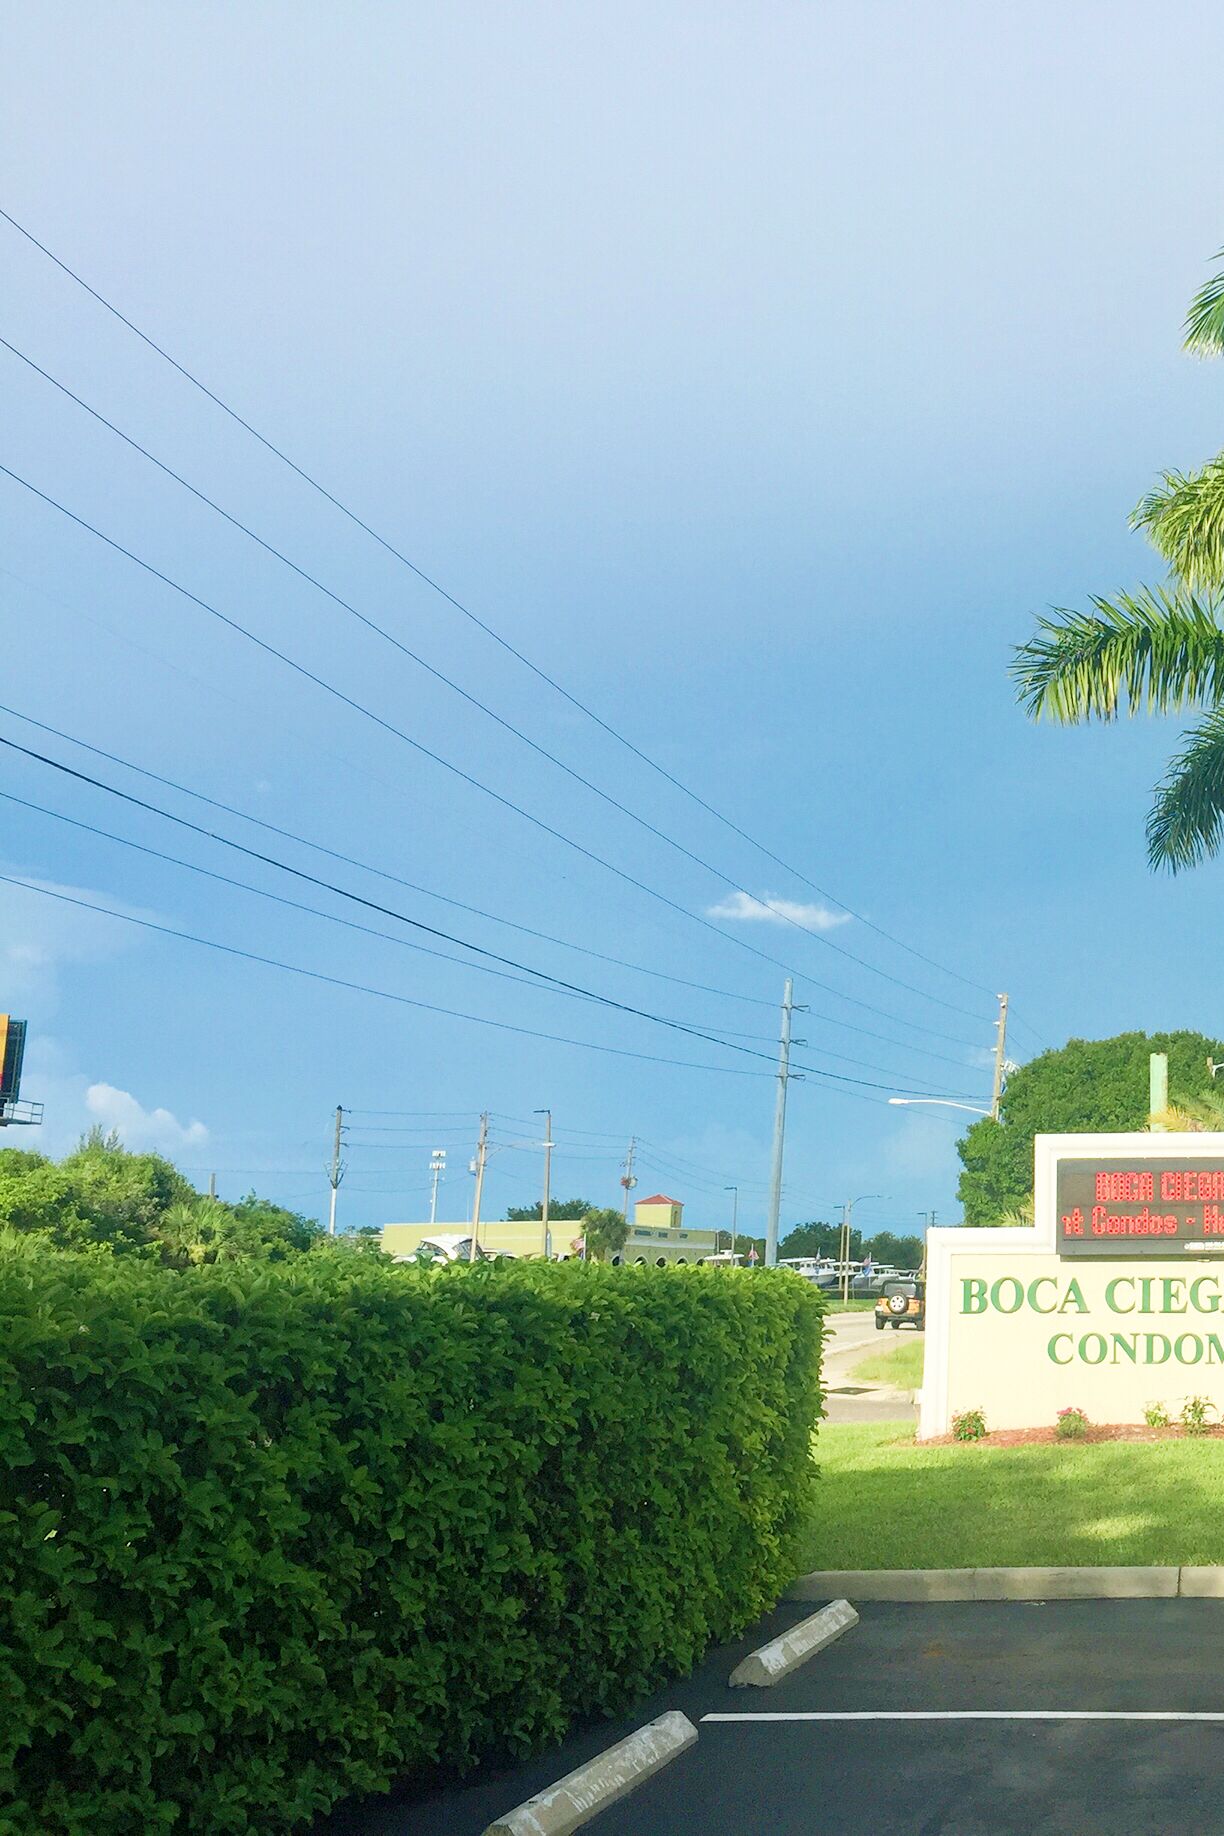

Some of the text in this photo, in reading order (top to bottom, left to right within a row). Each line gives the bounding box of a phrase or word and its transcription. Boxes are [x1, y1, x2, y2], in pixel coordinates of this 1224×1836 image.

[1095, 1172, 1154, 1202] BOCA
[1091, 1205, 1178, 1236] Condos
[959, 1276, 1091, 1315] BOCA
